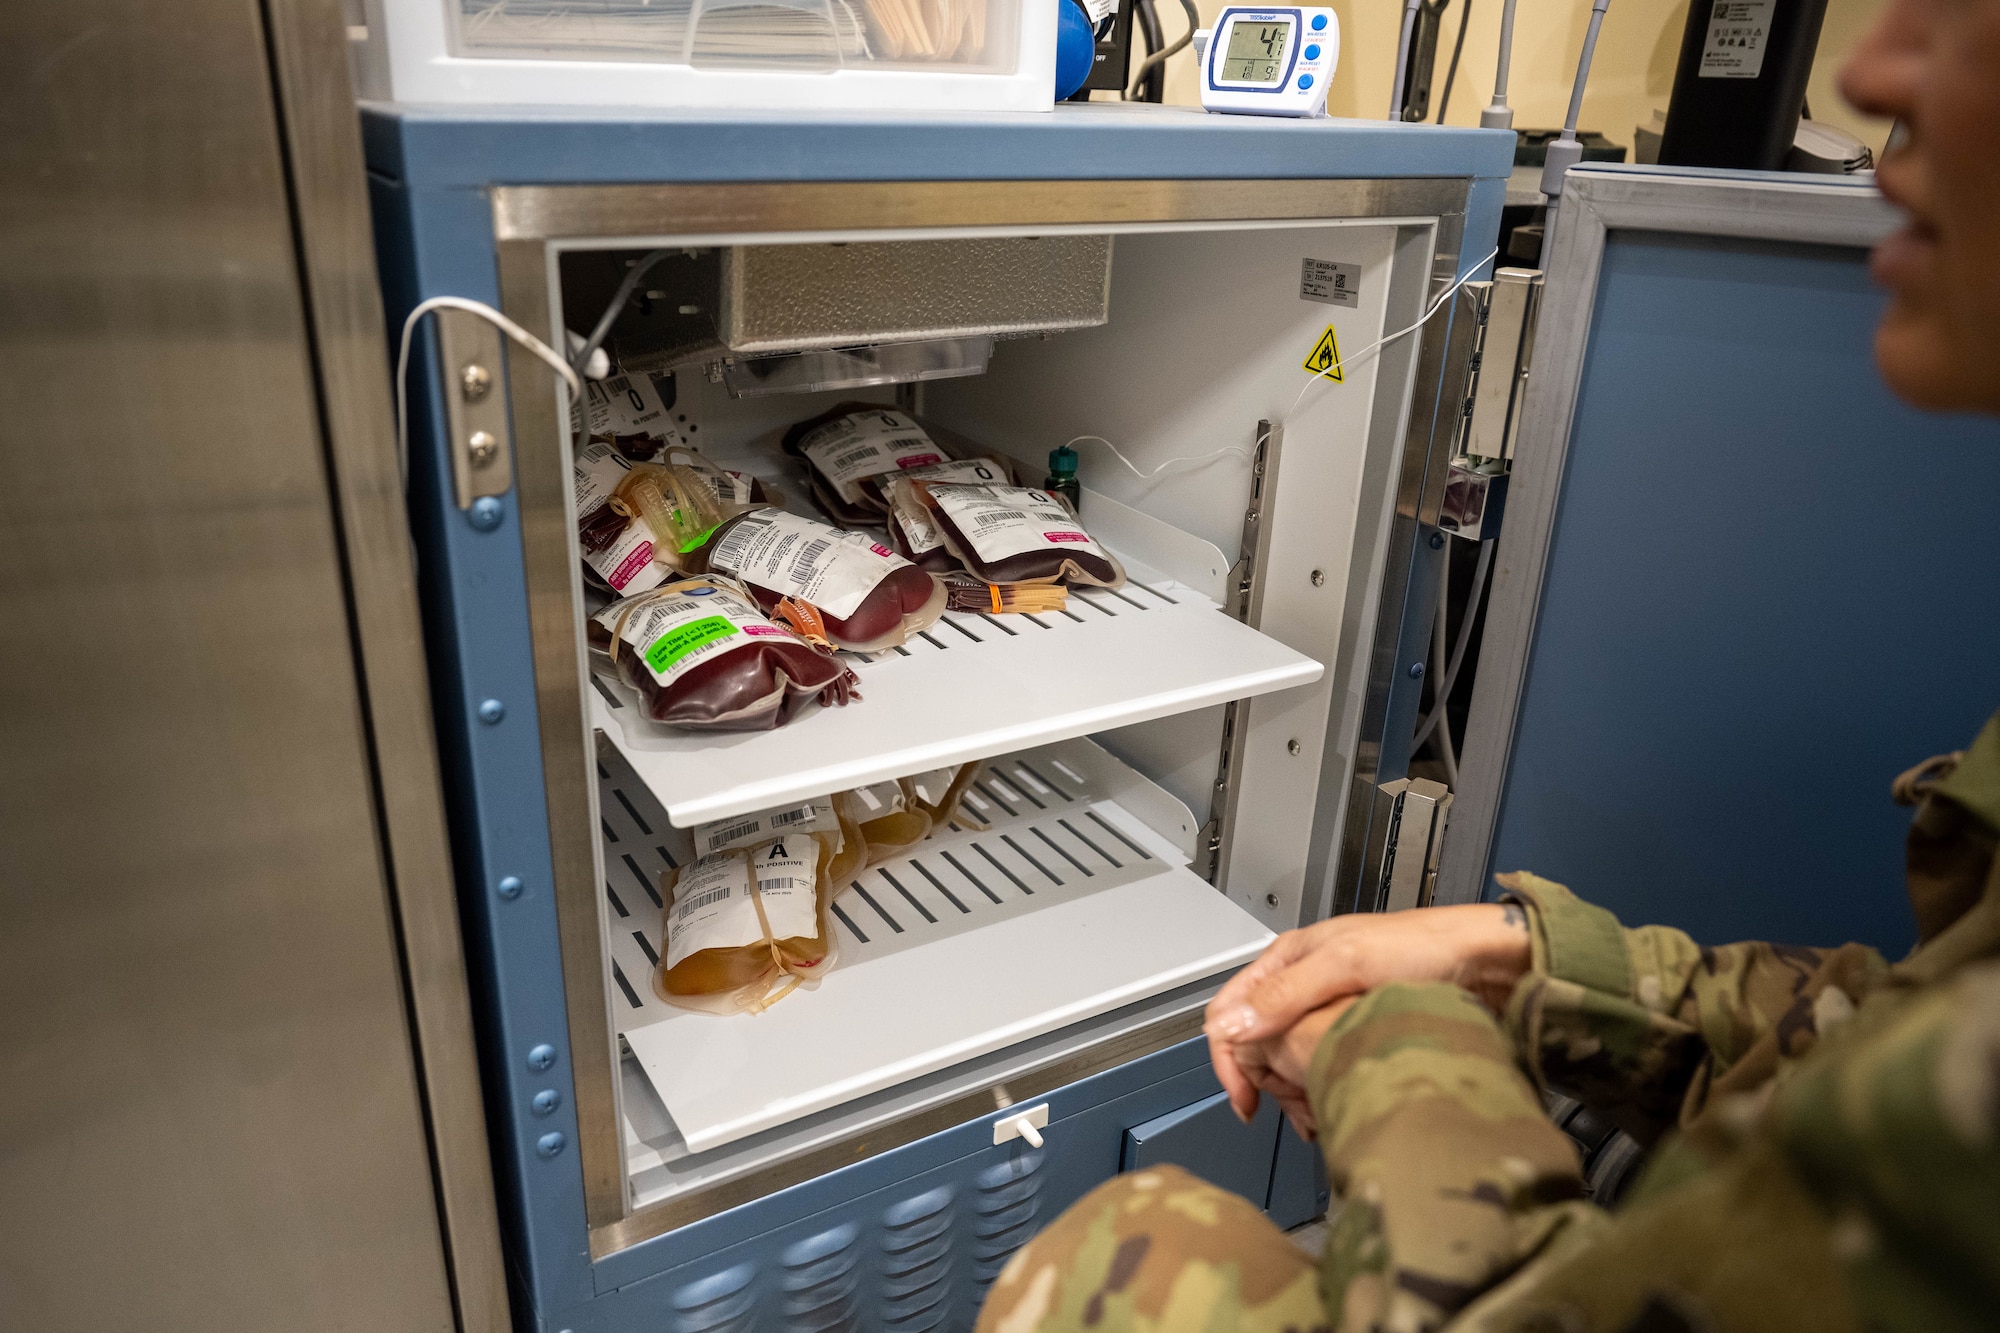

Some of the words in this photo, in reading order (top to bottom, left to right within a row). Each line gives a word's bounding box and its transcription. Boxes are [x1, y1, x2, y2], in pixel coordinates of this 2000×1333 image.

[617, 560, 630, 574] GROUP
[628, 542, 650, 562] CONFIRMED
[654, 645, 668, 659] Low
[668, 635, 684, 646] Titer
[658, 655, 668, 664] for
[669, 640, 690, 655] anti-A
[691, 632, 705, 642] and
[768, 844, 788, 860] A
